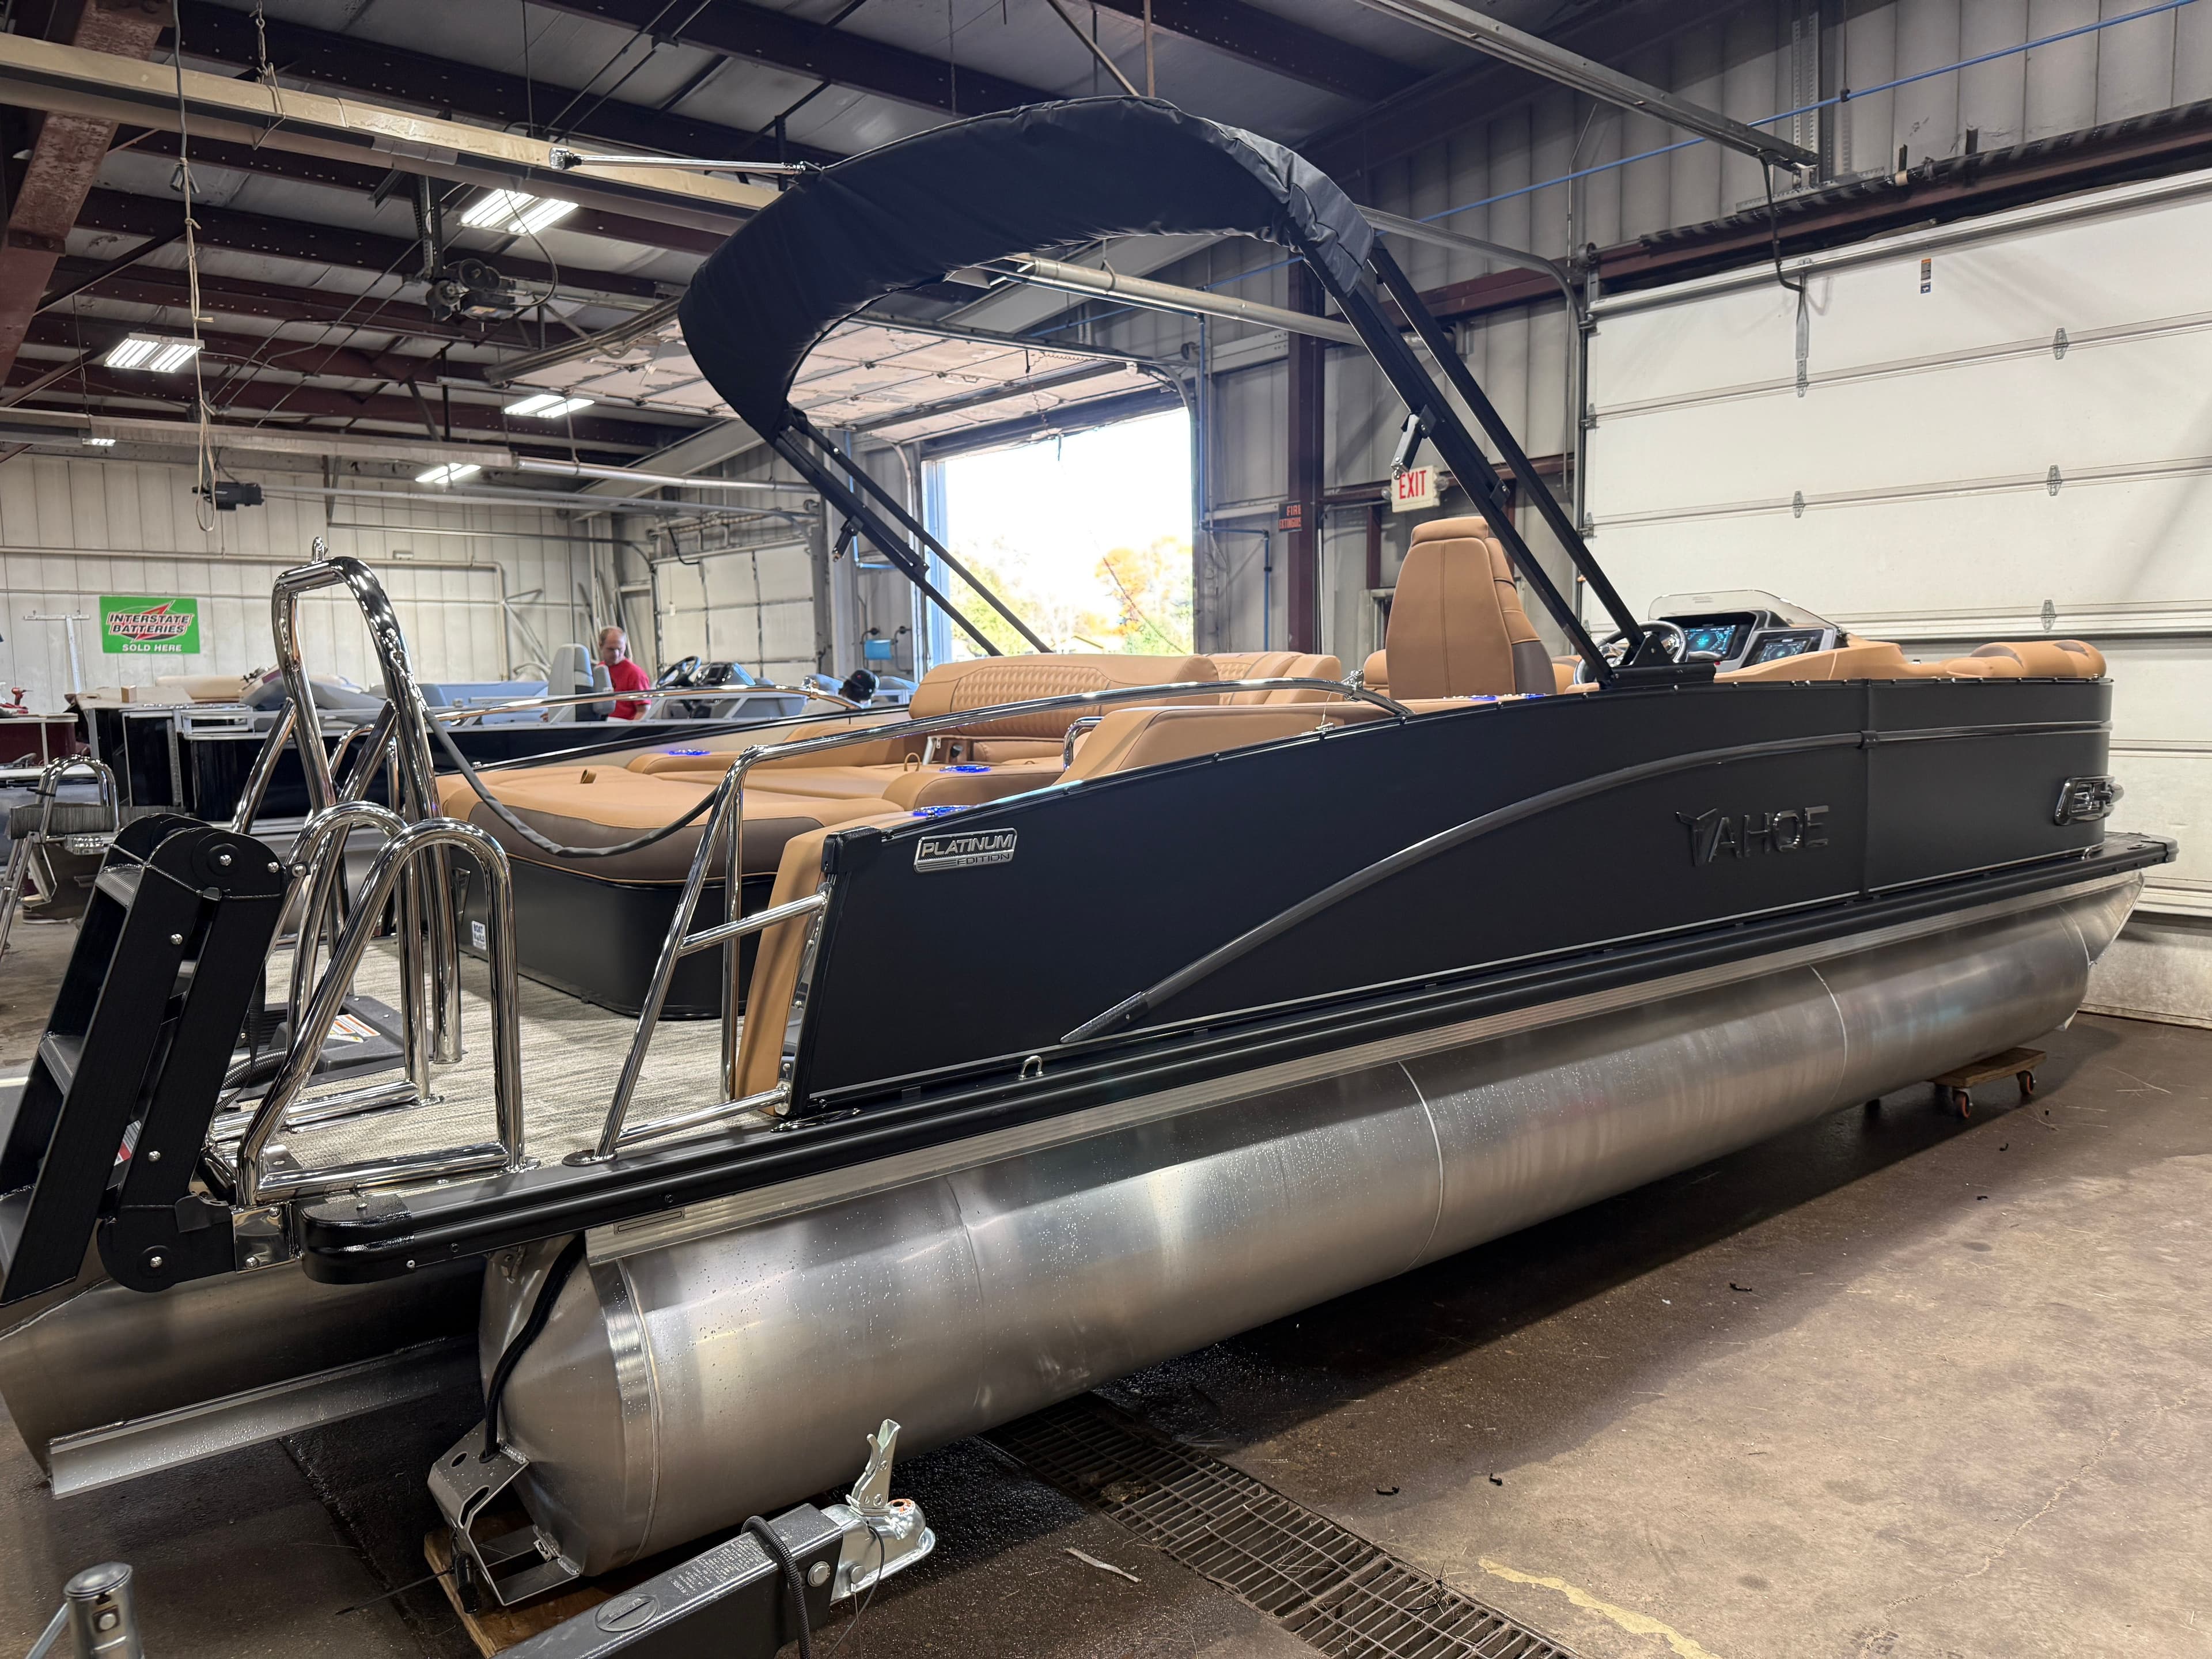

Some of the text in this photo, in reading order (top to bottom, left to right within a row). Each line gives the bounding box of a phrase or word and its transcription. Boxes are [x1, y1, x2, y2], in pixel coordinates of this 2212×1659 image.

[1399, 470, 1427, 499] EXIT
[109, 613, 191, 624] INTERSTATE
[112, 624, 185, 634] BATTERIES
[122, 643, 182, 652] SOLD HERE
[1675, 805, 1830, 867] TAHOE
[921, 834, 1013, 857] PLATINUM
[957, 853, 1010, 865] EDITION
